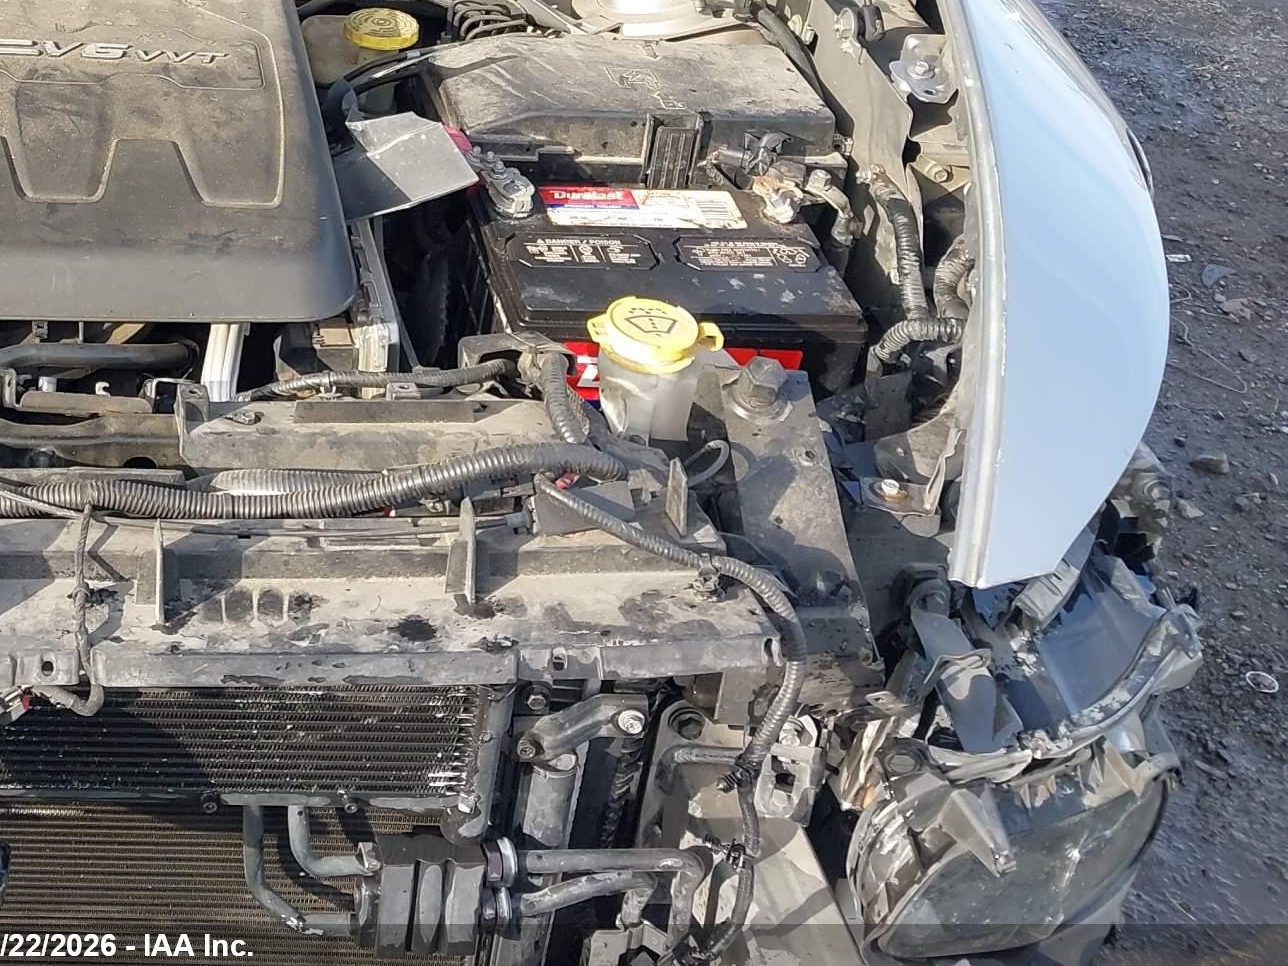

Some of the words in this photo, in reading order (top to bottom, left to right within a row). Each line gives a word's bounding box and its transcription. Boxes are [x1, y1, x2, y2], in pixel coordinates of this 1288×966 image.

[43, 40, 133, 60] V6
[135, 50, 230, 64] VVT
[549, 190, 624, 200] Duralast
